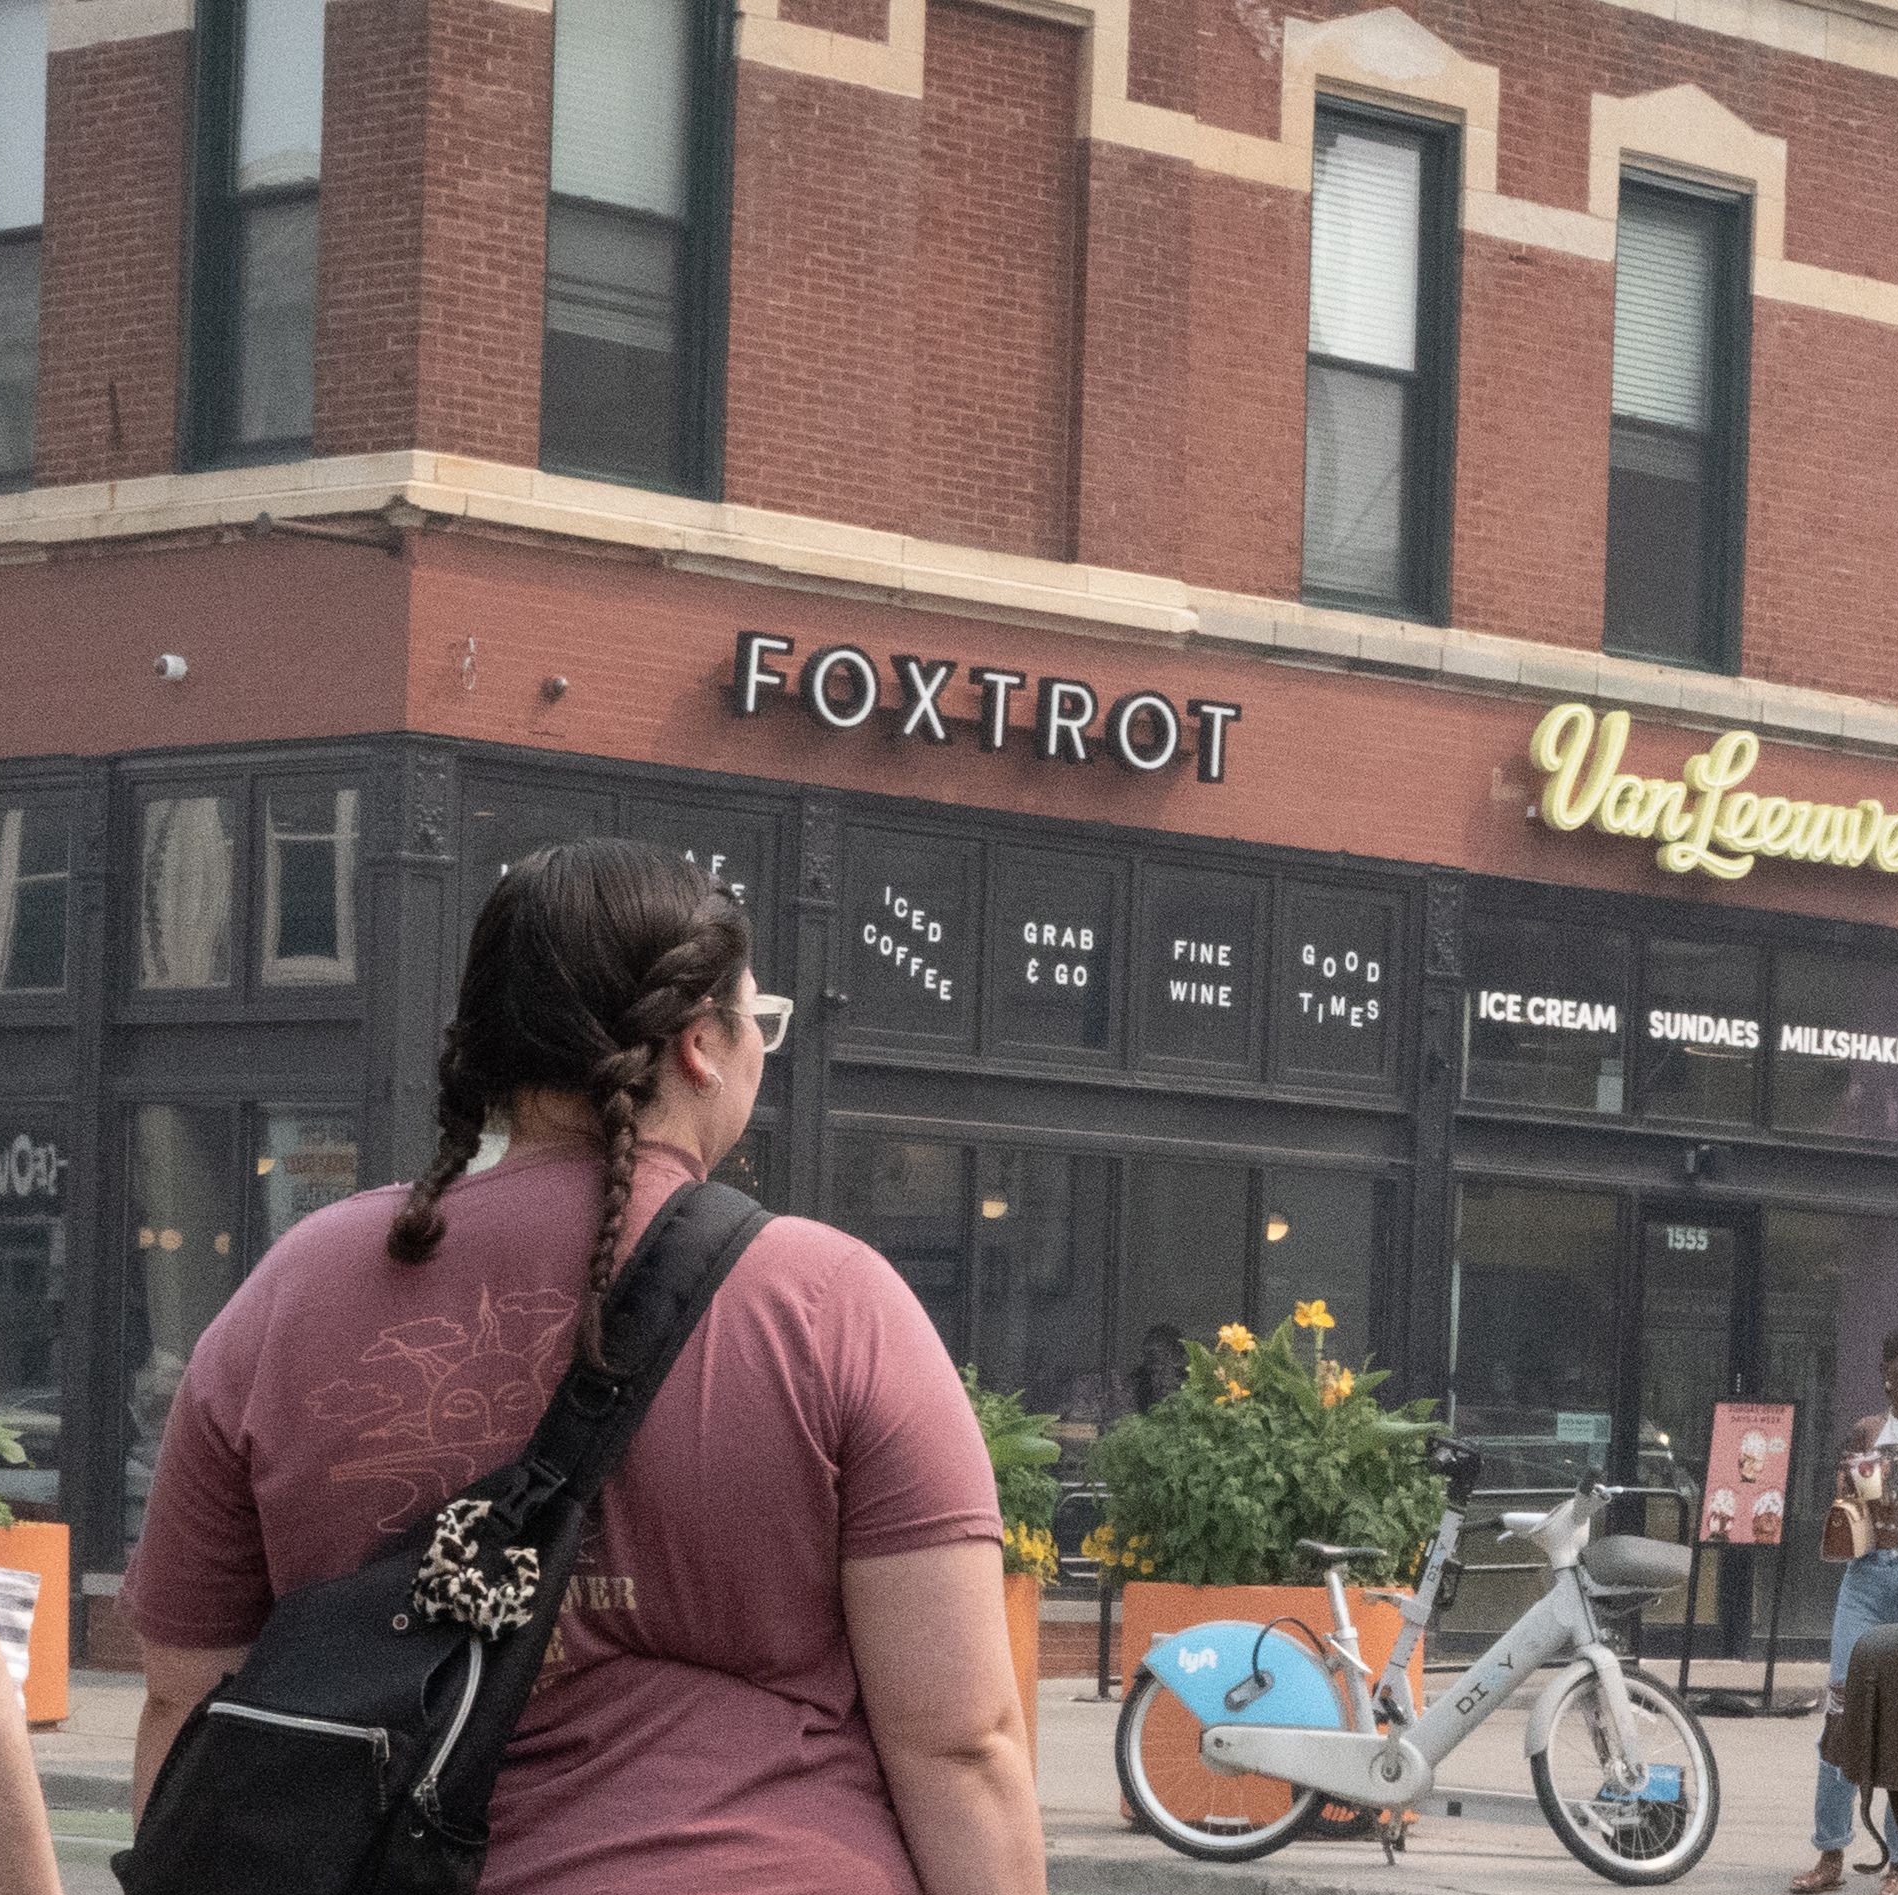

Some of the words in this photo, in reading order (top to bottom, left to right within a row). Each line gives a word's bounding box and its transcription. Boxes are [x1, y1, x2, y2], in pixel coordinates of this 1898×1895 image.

[737, 632, 1242, 783] FOXTROT
[1531, 703, 1696, 838] Van
[885, 886, 942, 942] ICED
[1023, 921, 1094, 951] GRAB
[1174, 940, 1232, 966] FINE
[863, 924, 952, 1001] COFFEE
[1026, 959, 1040, 983] &
[1055, 961, 1089, 987] GO
[1302, 944, 1380, 983] GOOD
[1169, 980, 1232, 1007] WINE
[1300, 992, 1380, 1027] TIMES
[1479, 992, 1521, 1024] ICE
[1526, 997, 1617, 1032] CREAM
[1649, 1011, 1759, 1049] SUNDAES
[1666, 1226, 1709, 1251] 1555
[1177, 1646, 1218, 1674] lyft
